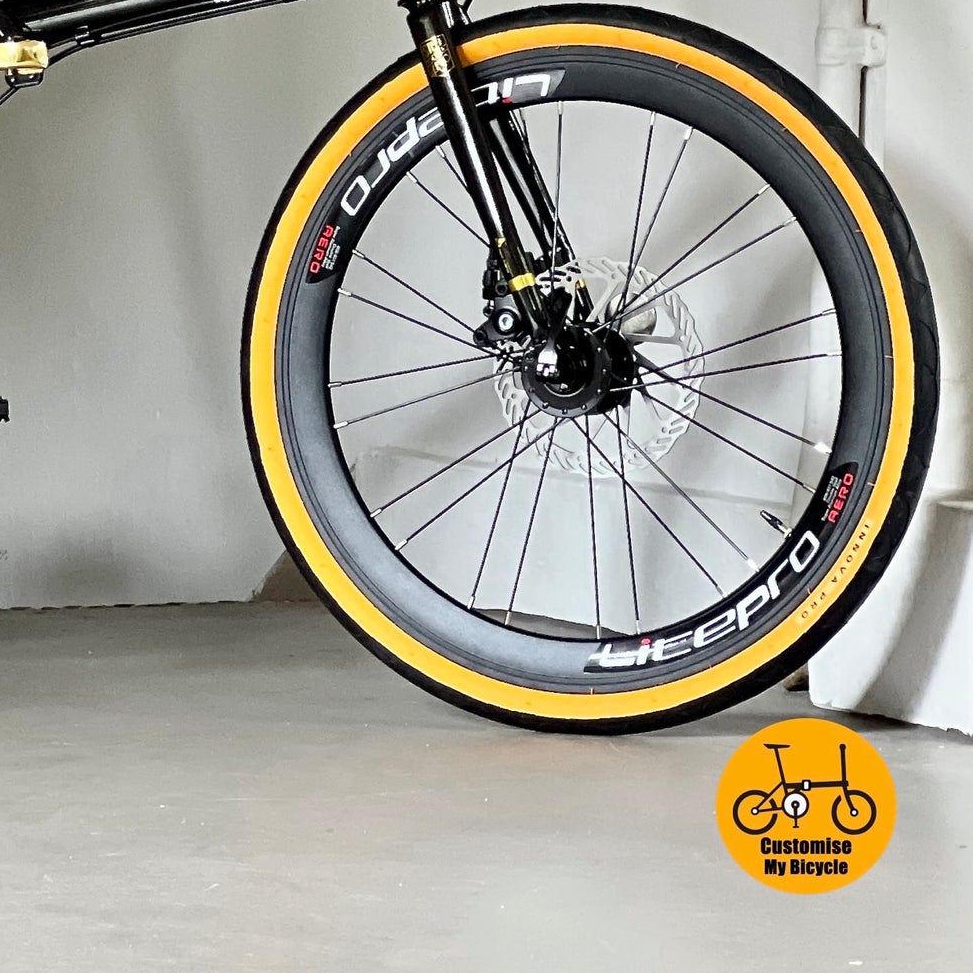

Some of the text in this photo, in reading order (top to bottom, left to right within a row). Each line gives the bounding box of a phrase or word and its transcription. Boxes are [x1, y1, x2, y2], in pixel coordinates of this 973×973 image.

[309, 224, 334, 274] AERO
[827, 473, 854, 524] AERO
[830, 524, 871, 584] INNOVA
[801, 592, 827, 620] PRO
